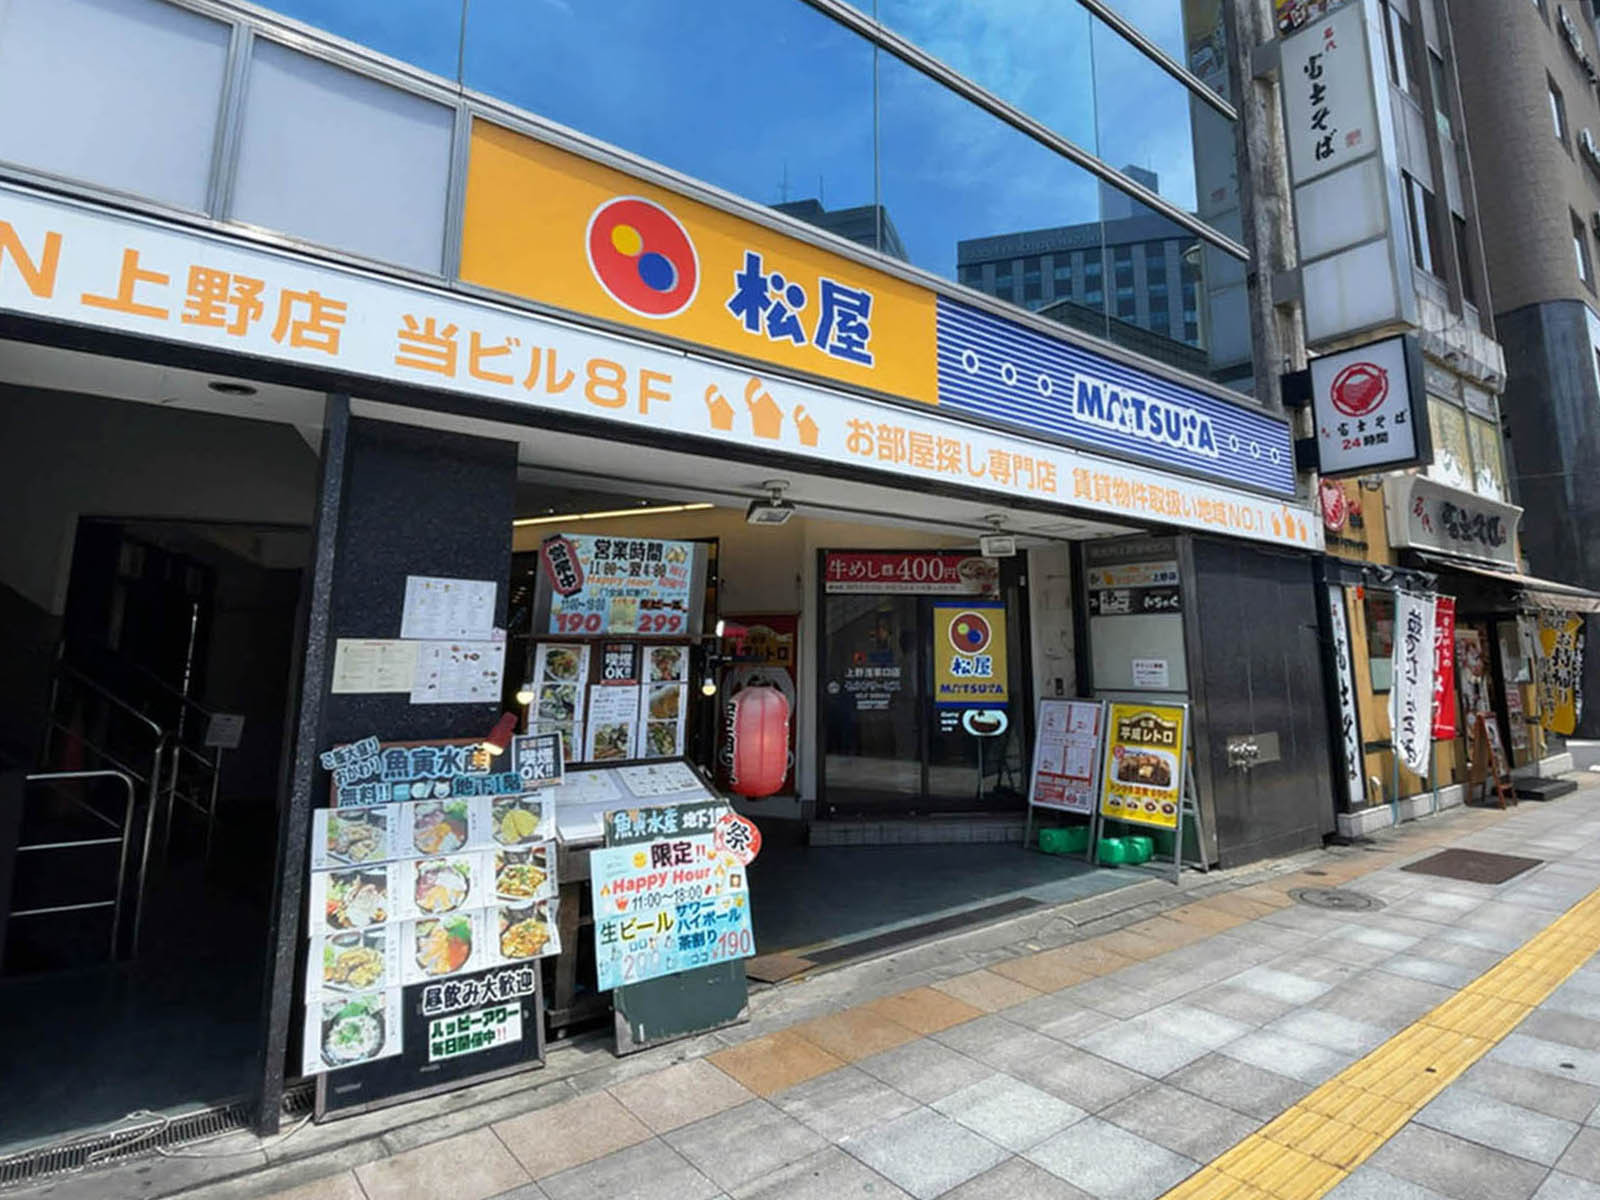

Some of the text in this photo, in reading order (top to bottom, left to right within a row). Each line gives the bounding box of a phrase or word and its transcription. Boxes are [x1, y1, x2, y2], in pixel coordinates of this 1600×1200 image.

[727, 250, 875, 368] 松屋
[0, 219, 62, 298] N
[81, 248, 347, 355] 上野店
[394, 314, 672, 414] 当ビル8F
[844, 417, 1058, 493] お部屋探し専門店
[1074, 374, 1218, 458] MATSUYA
[1342, 431, 1389, 450] 24時間
[594, 539, 664, 562] 営業時間
[555, 613, 602, 632] 190
[637, 613, 681, 632] 299
[952, 656, 993, 678] 松屋
[726, 821, 751, 851] 祭
[612, 867, 711, 895] Happy Hour
[676, 900, 715, 917] サワー
[677, 908, 741, 933] ハイボール
[600, 912, 674, 945] 生ビール
[679, 929, 718, 951] 茶割り
[424, 969, 534, 1013] 昼飲み大歓迎
[431, 1007, 520, 1038] ハッピーアワー
